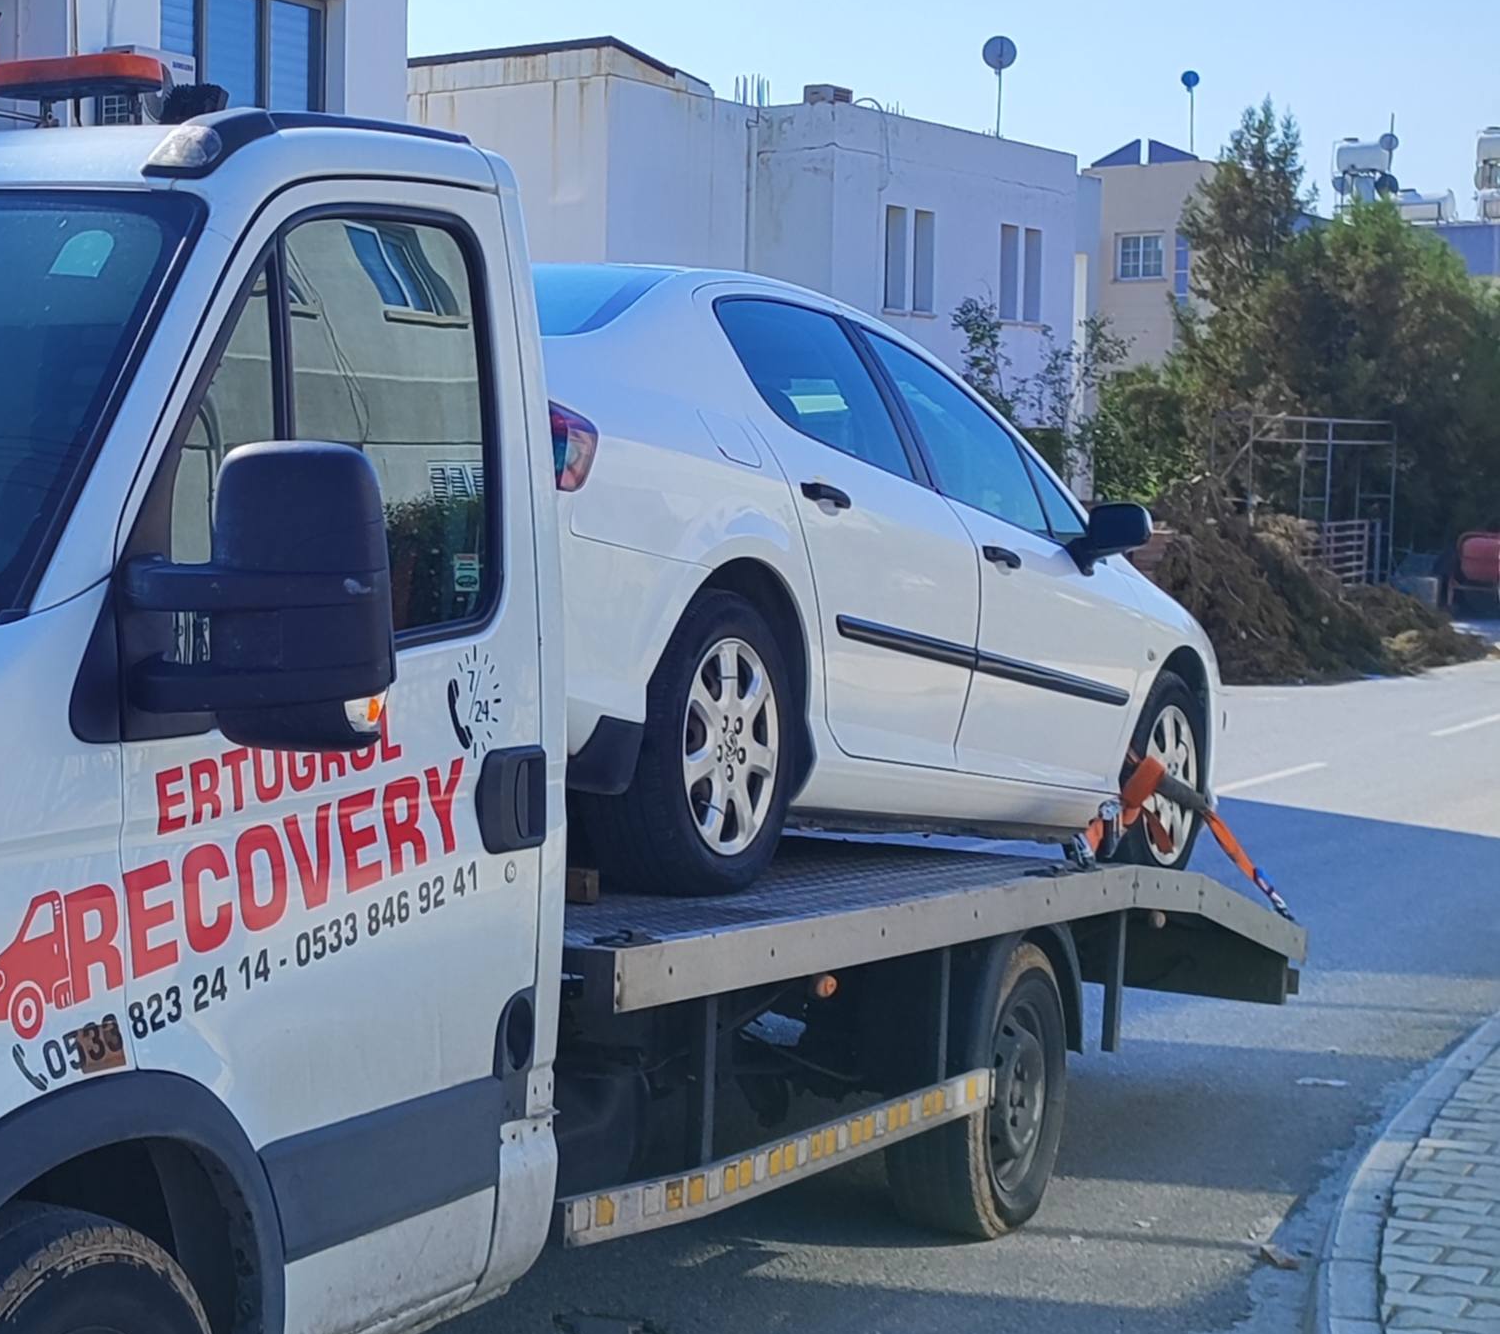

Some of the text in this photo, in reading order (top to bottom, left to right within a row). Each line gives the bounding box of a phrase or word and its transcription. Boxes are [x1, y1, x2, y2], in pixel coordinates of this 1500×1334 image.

[42, 1013, 124, 1080] 0533
[128, 986, 183, 1040] 823
[193, 966, 228, 1013] 24
[238, 948, 271, 990] 14
[296, 912, 358, 967] 0533
[367, 890, 410, 937] 846
[418, 875, 445, 914] 92
[453, 861, 478, 898] 41
[64, 757, 465, 1006] RECOVERY
